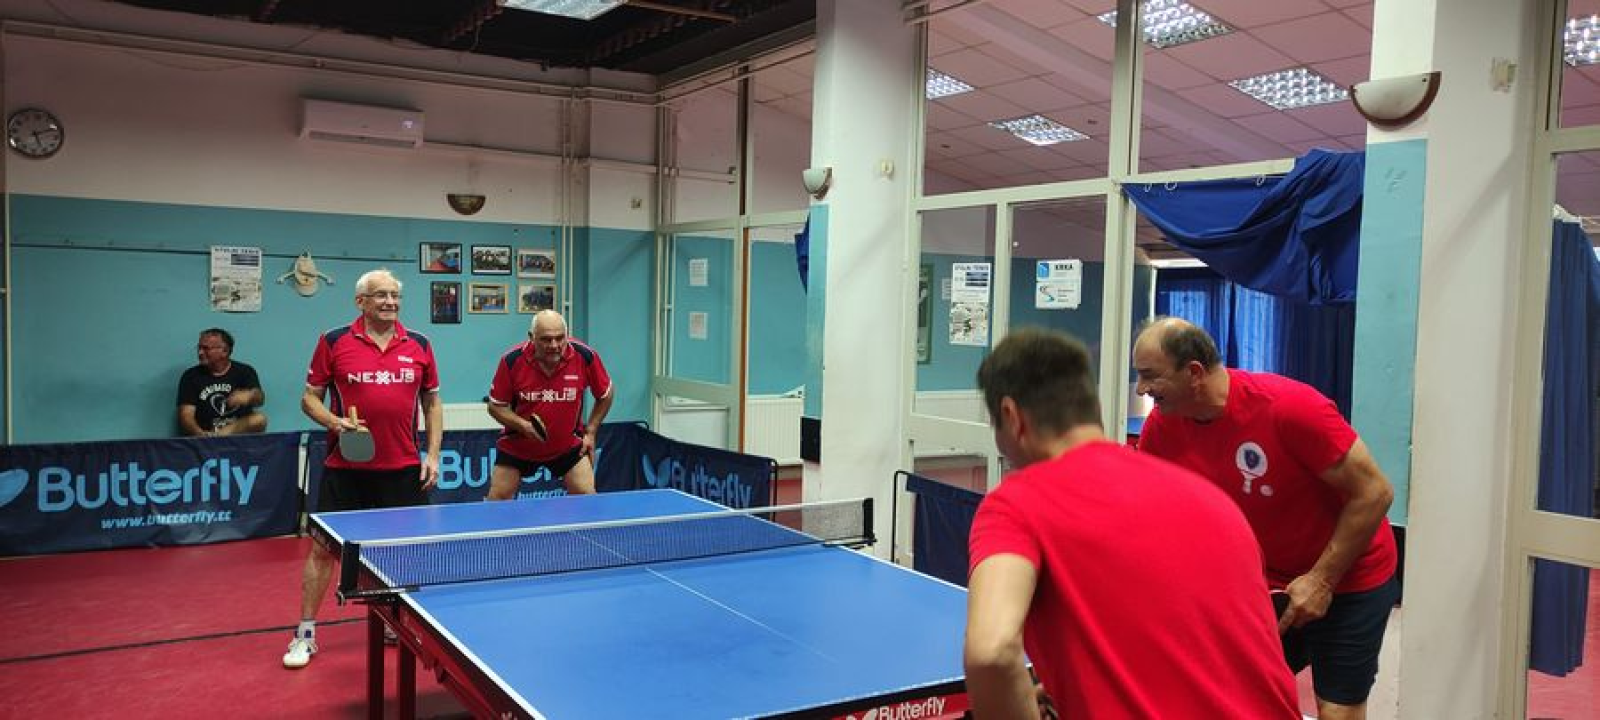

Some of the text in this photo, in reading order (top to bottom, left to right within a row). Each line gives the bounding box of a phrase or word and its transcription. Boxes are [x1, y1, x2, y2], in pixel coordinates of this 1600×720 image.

[347, 370, 415, 385] NEXUS
[519, 388, 577, 402] NEXUS
[37, 457, 259, 513] Butterfly
[879, 696, 946, 720] Butterfly
